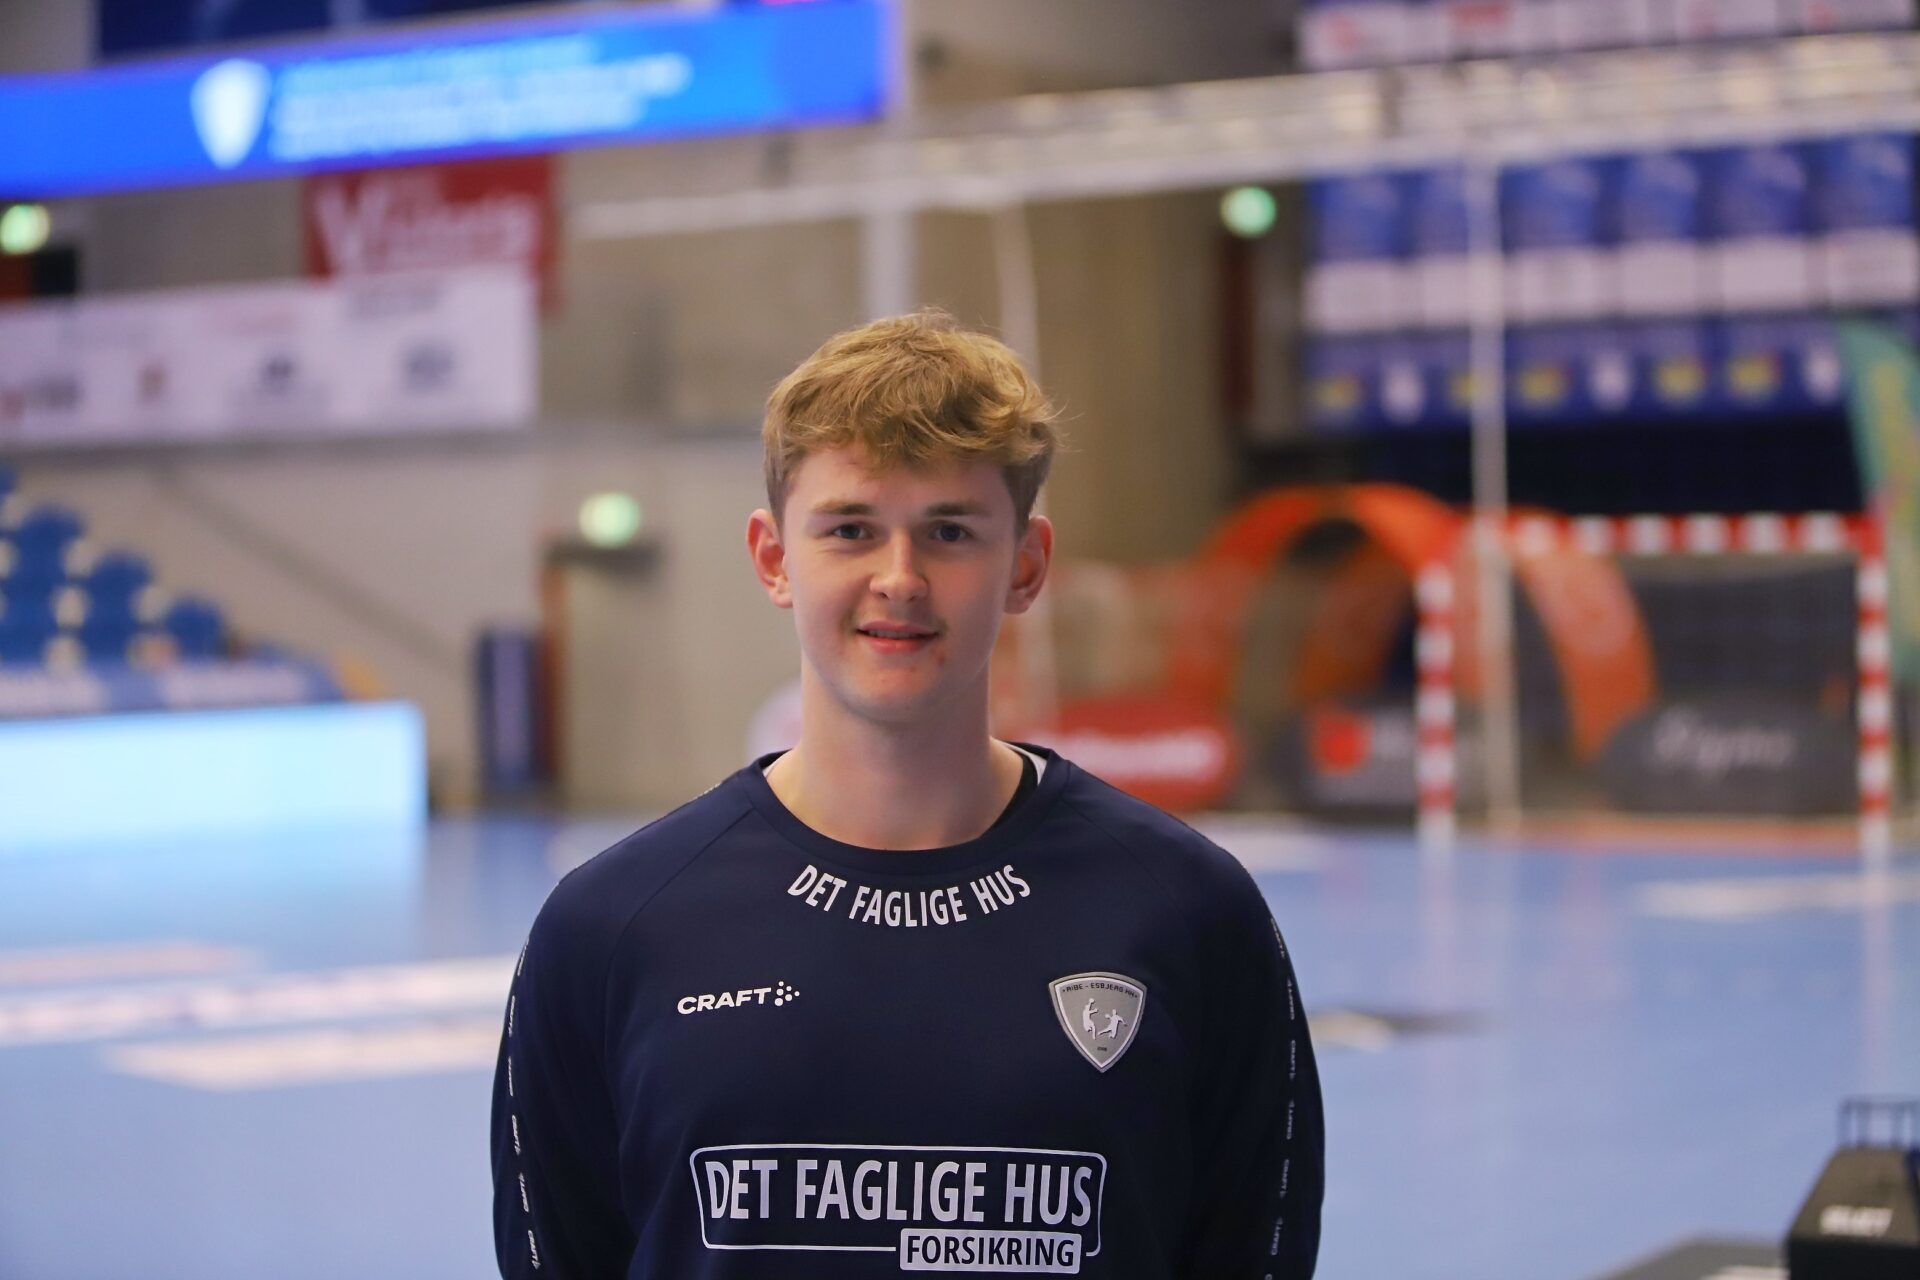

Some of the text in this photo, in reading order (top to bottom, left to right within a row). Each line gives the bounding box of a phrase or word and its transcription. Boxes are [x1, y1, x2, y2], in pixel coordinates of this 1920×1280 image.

[787, 864, 1031, 927] DET FAGLIGE HUS
[677, 987, 772, 1015] CRAFT
[705, 1159, 1092, 1227] DET FAGLIGE HUS
[907, 1234, 1075, 1267] FORSIKRING
